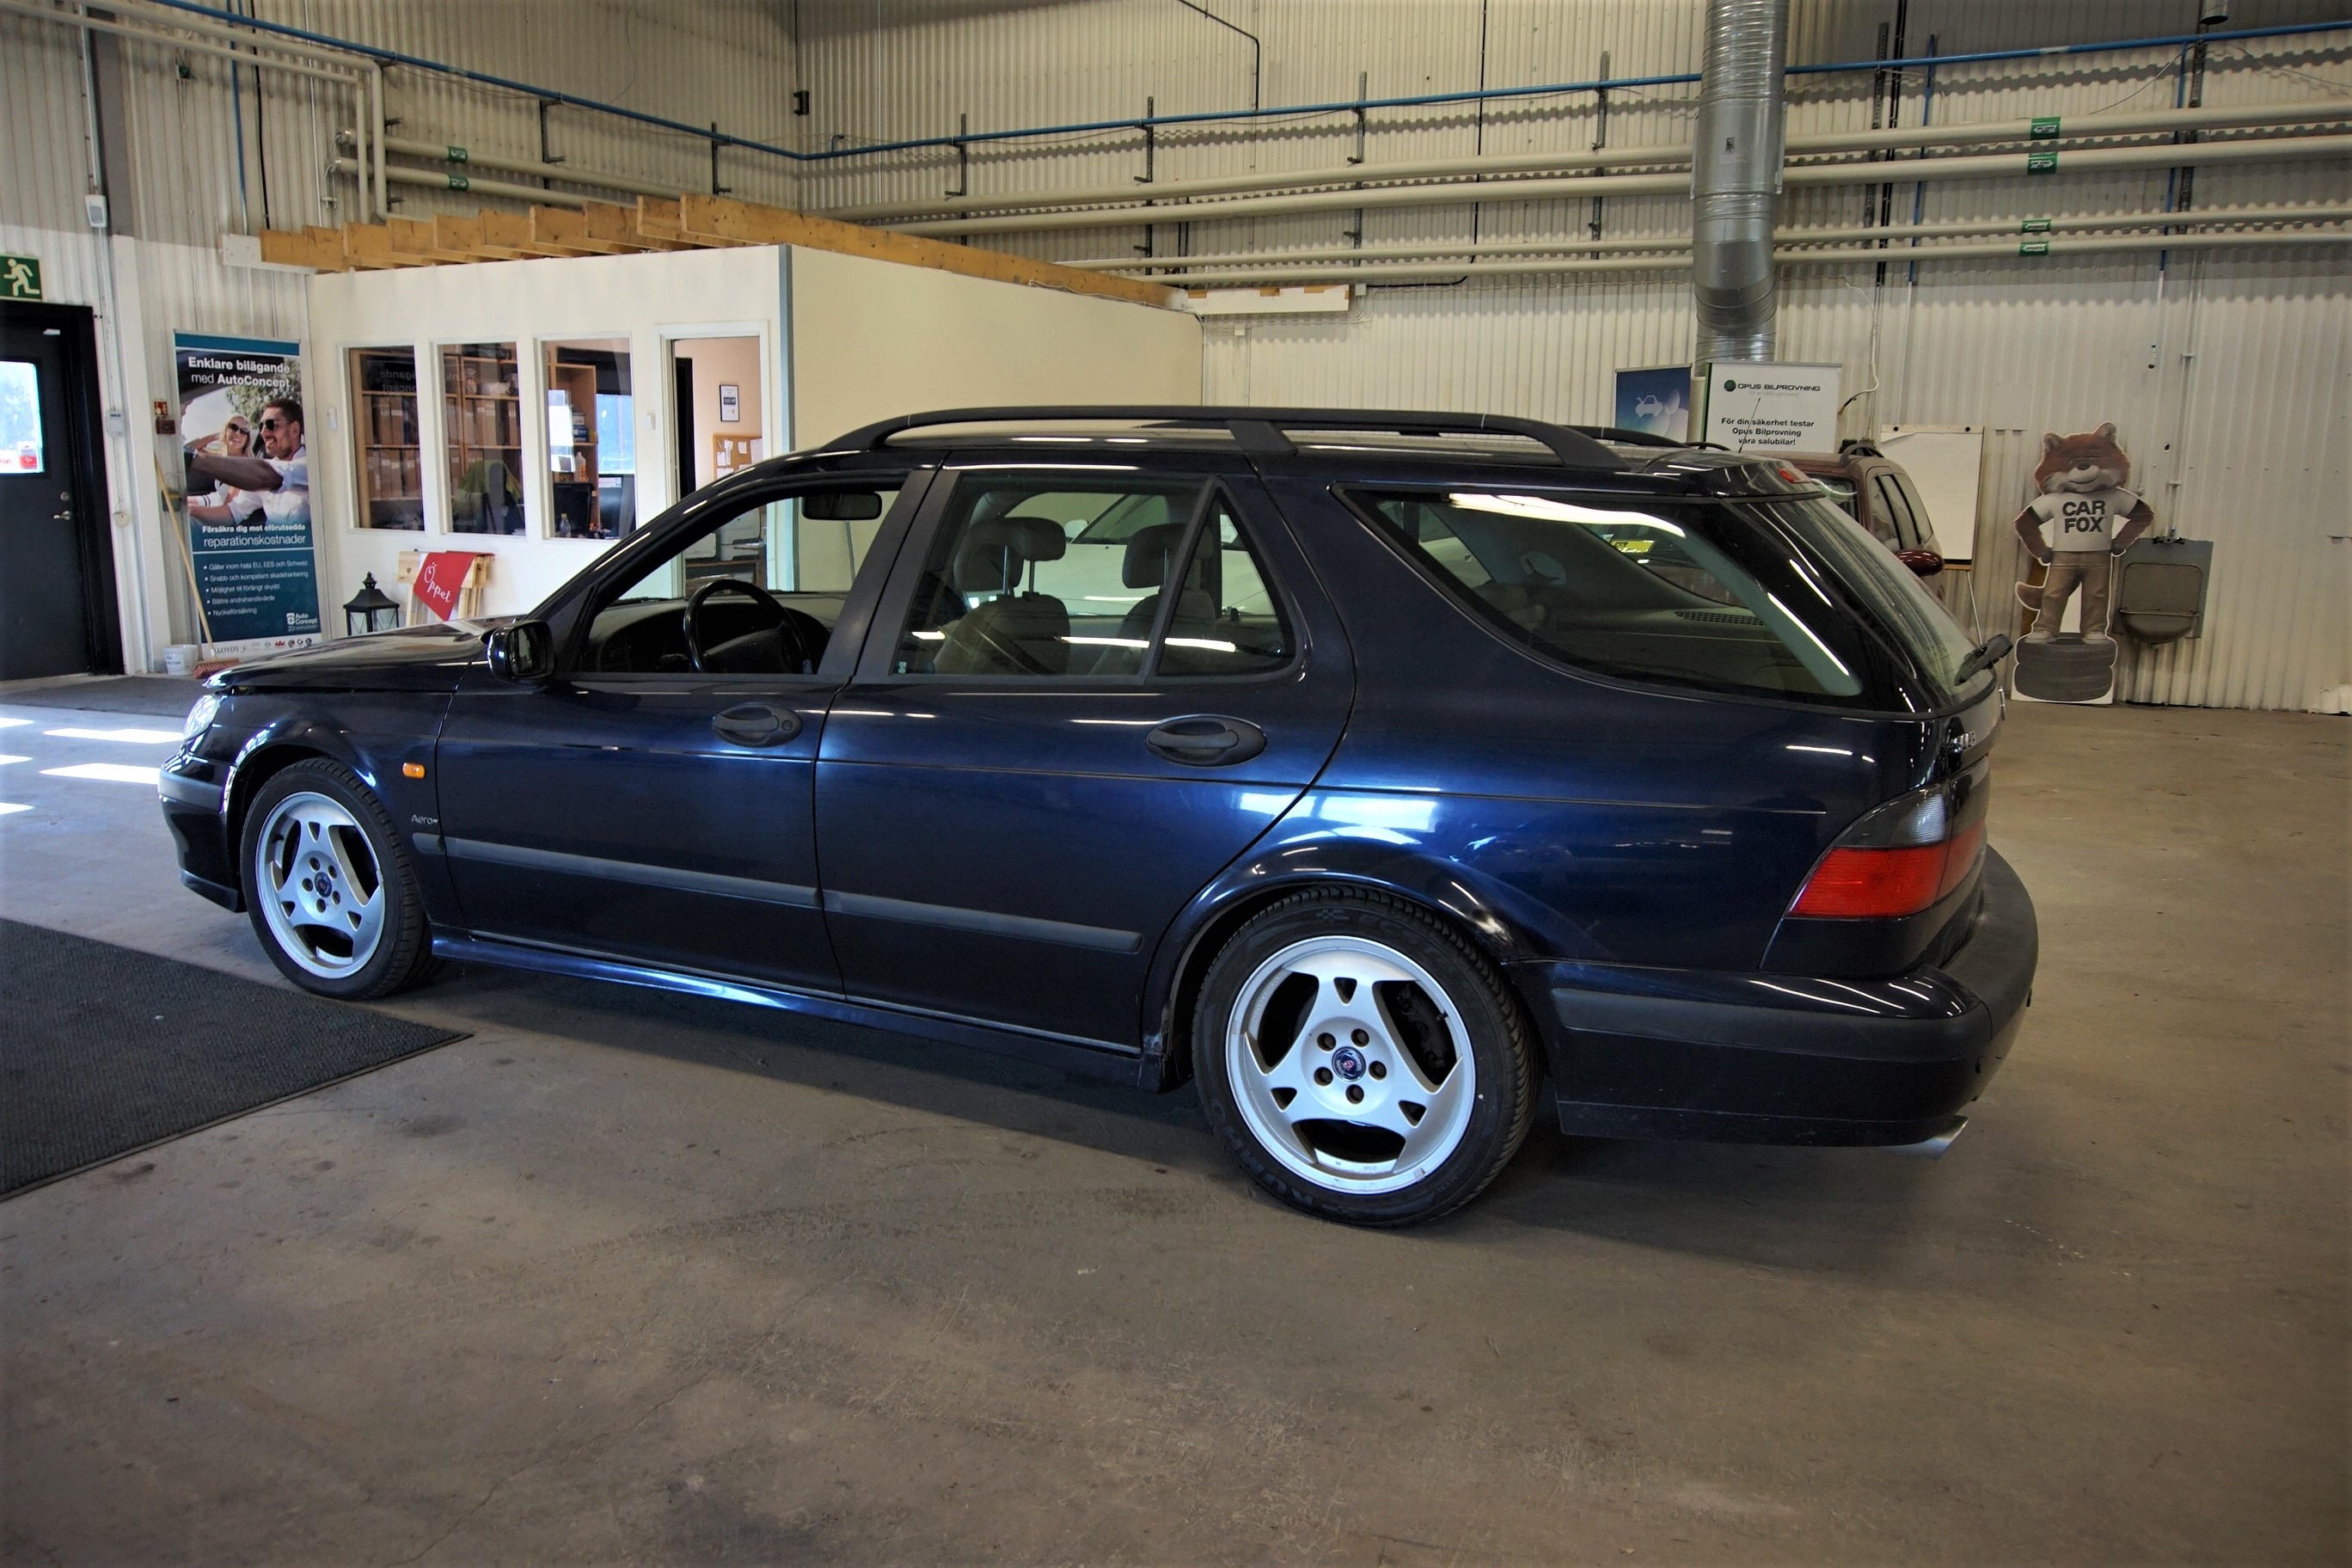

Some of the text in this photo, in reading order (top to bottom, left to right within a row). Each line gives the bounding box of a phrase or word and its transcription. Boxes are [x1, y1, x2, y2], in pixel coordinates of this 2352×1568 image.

[187, 356, 291, 374] Enklare bilägande
[191, 373, 291, 389] med AutoConcept
[1764, 383, 1821, 392] BILPROVNING
[1721, 417, 1815, 427] För din säkerhet testar
[1732, 427, 1802, 438] Opus Bilprovning
[1758, 438, 1796, 446] salubilar!
[2062, 500, 2105, 516] CAR
[202, 525, 235, 534] Försäkra
[264, 524, 306, 532] oförutsedda
[2065, 517, 2104, 533] FOX
[204, 534, 306, 548] reparationskostnader
[424, 561, 451, 603] Öppet
[295, 617, 317, 626] Concept
[411, 814, 432, 825] Aero
